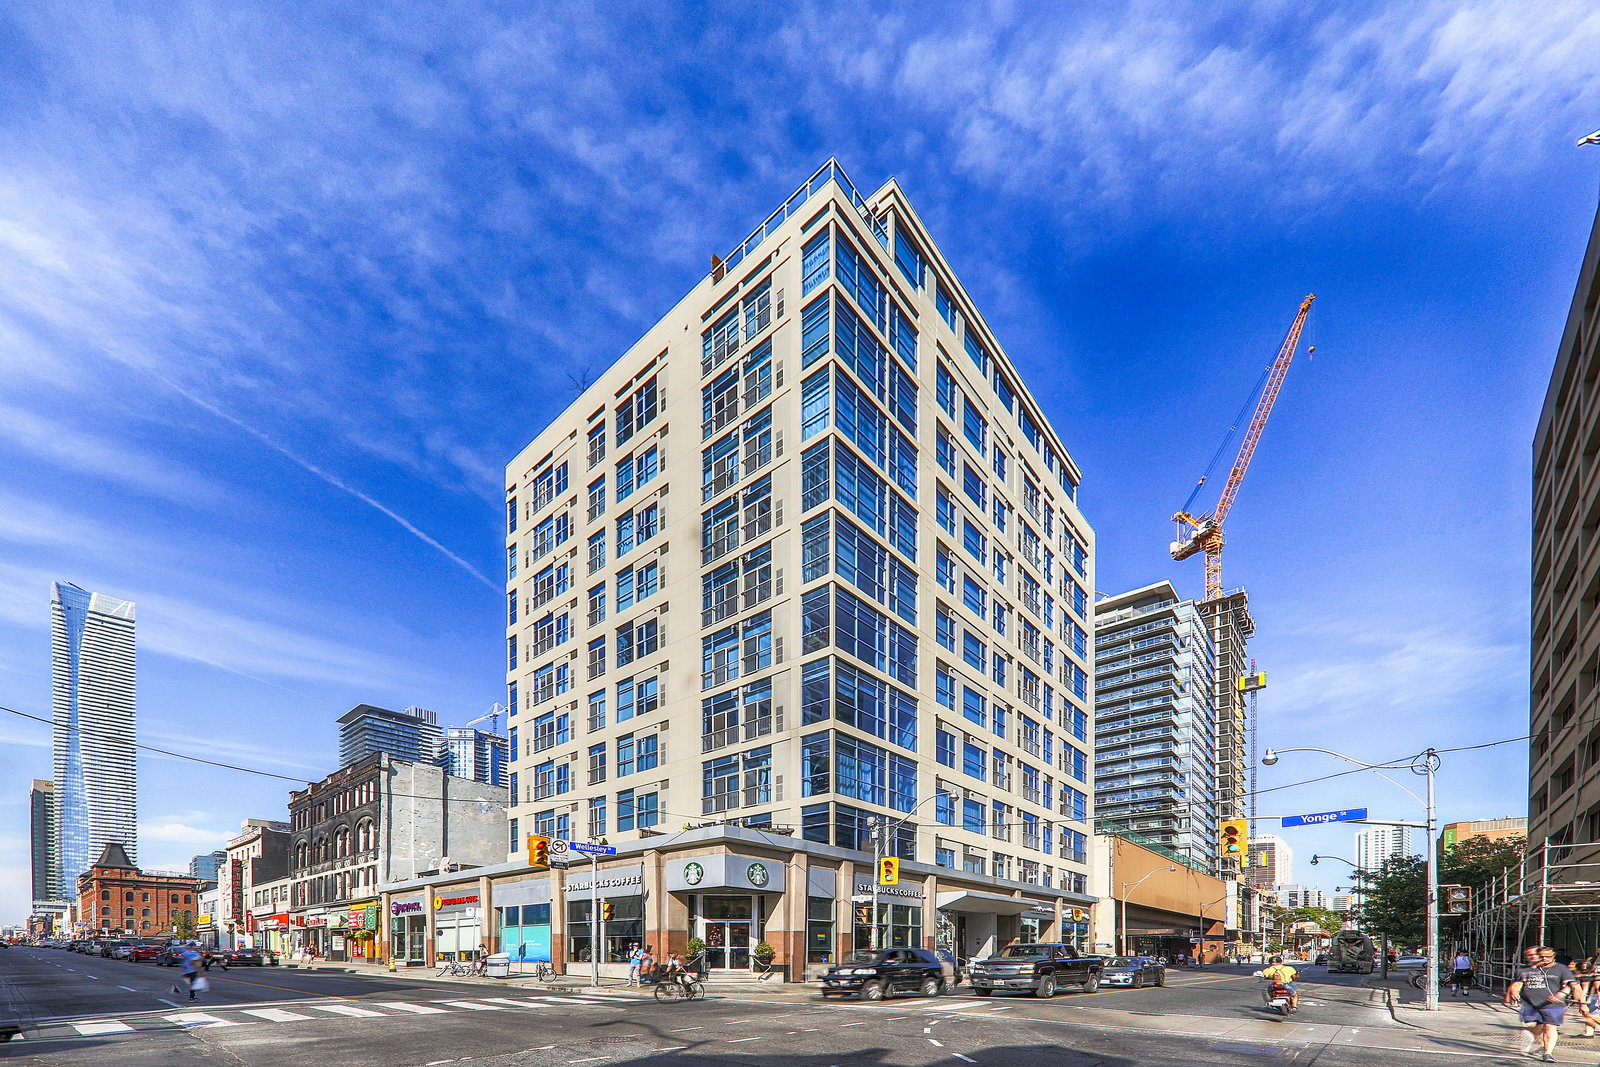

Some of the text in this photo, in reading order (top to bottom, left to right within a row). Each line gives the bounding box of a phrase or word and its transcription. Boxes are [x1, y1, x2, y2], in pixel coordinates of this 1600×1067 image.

[1300, 813, 1338, 823] Yonge
[575, 843, 607, 853] Wellesley
[566, 875, 642, 892] STARBCKS COFFEE
[858, 884, 923, 898] STABUCKS COFFEE
